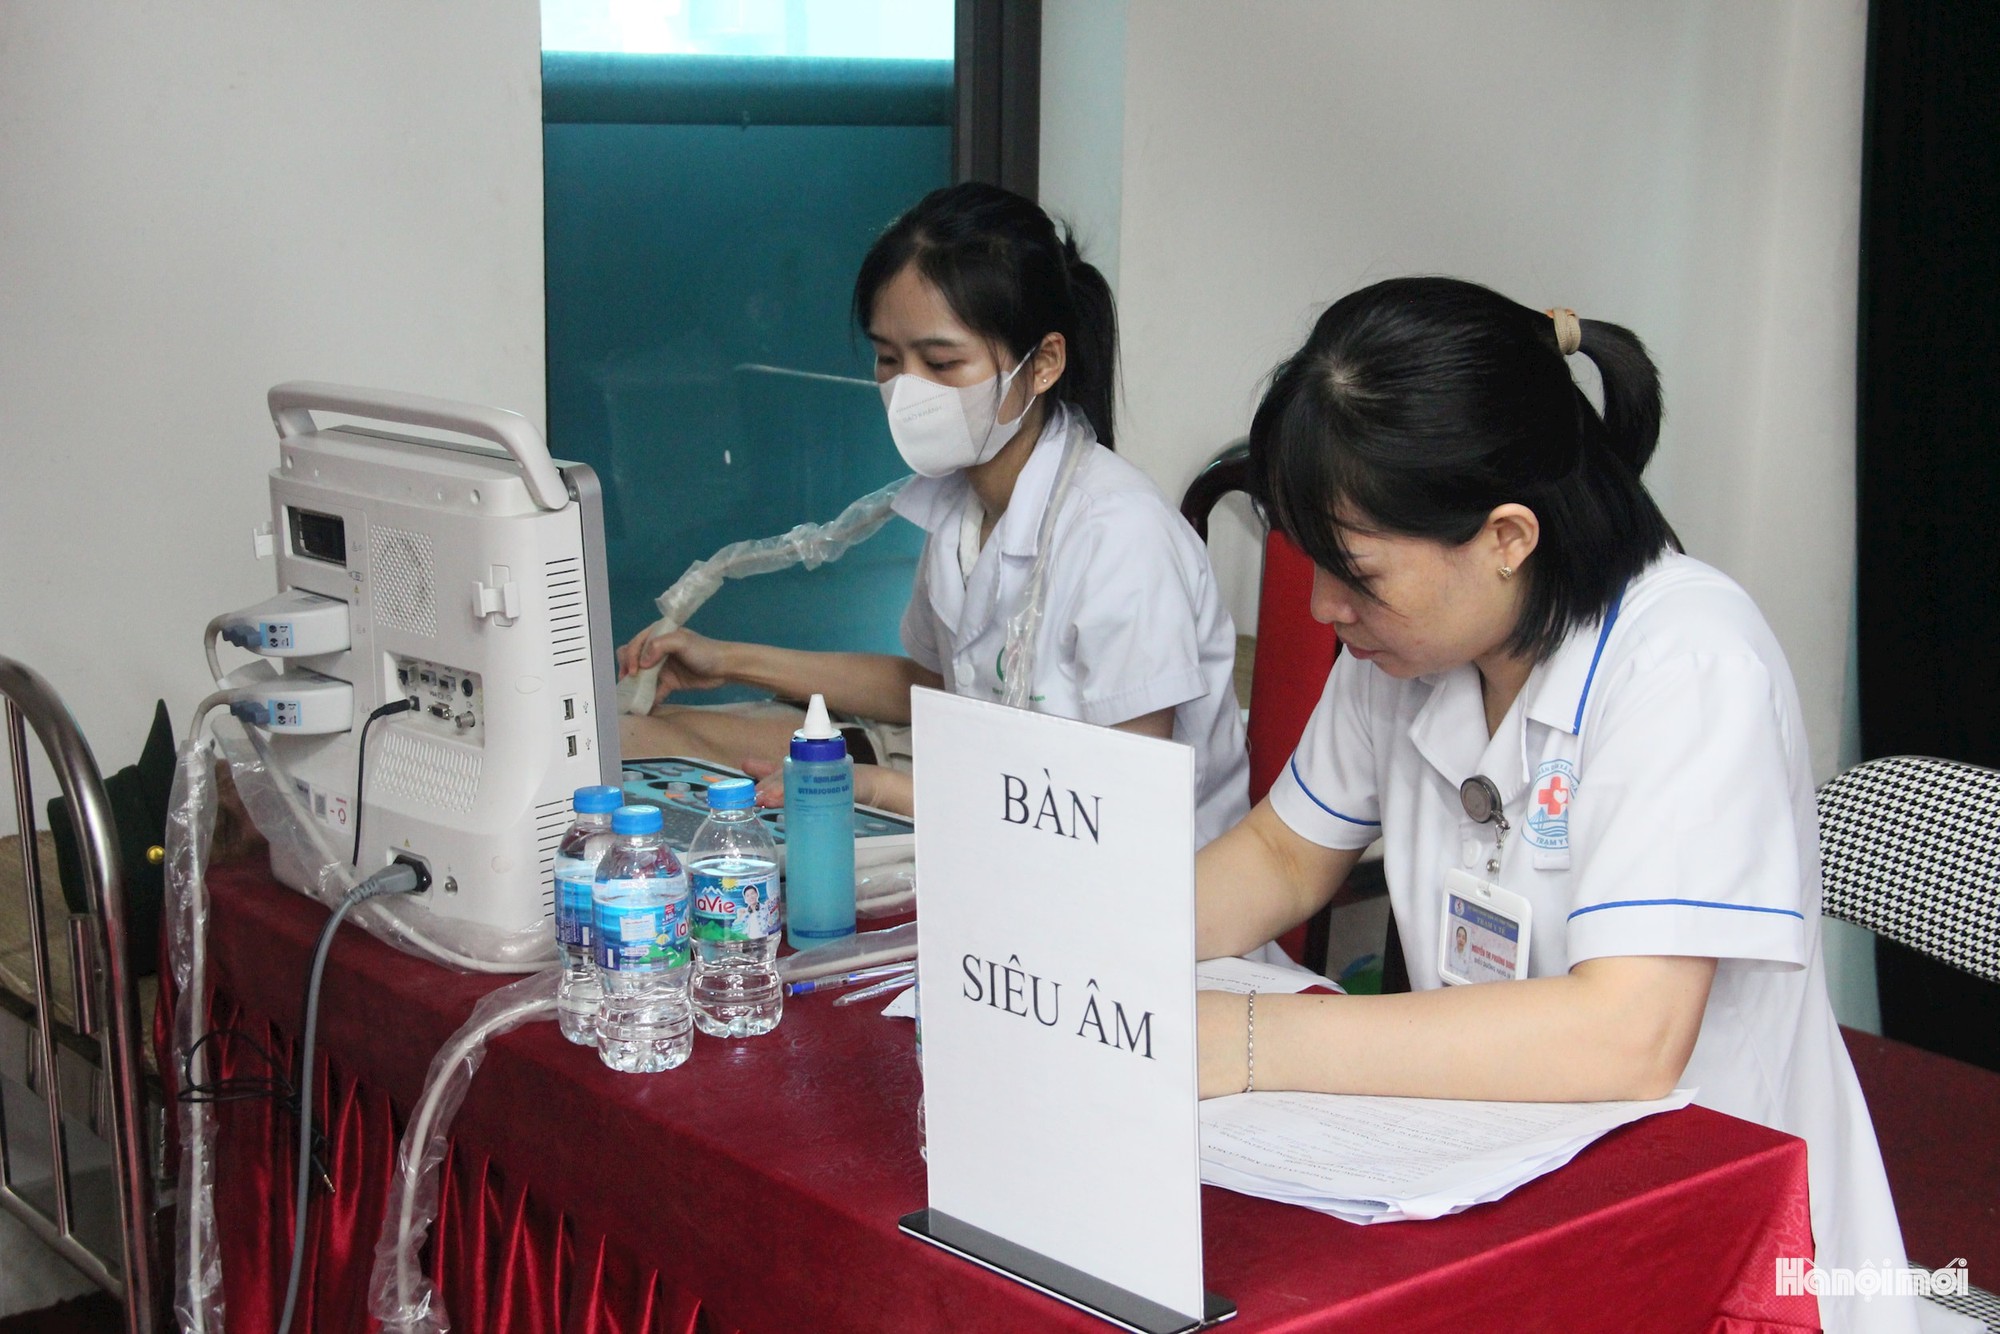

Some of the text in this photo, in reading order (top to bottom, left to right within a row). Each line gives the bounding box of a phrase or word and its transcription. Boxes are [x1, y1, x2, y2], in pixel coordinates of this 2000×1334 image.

[1000, 768, 1103, 845] BÀN
[1536, 836, 1557, 848] TRẠM
[694, 894, 736, 914] laVie
[962, 954, 1156, 1060] SIÊU ÂM
